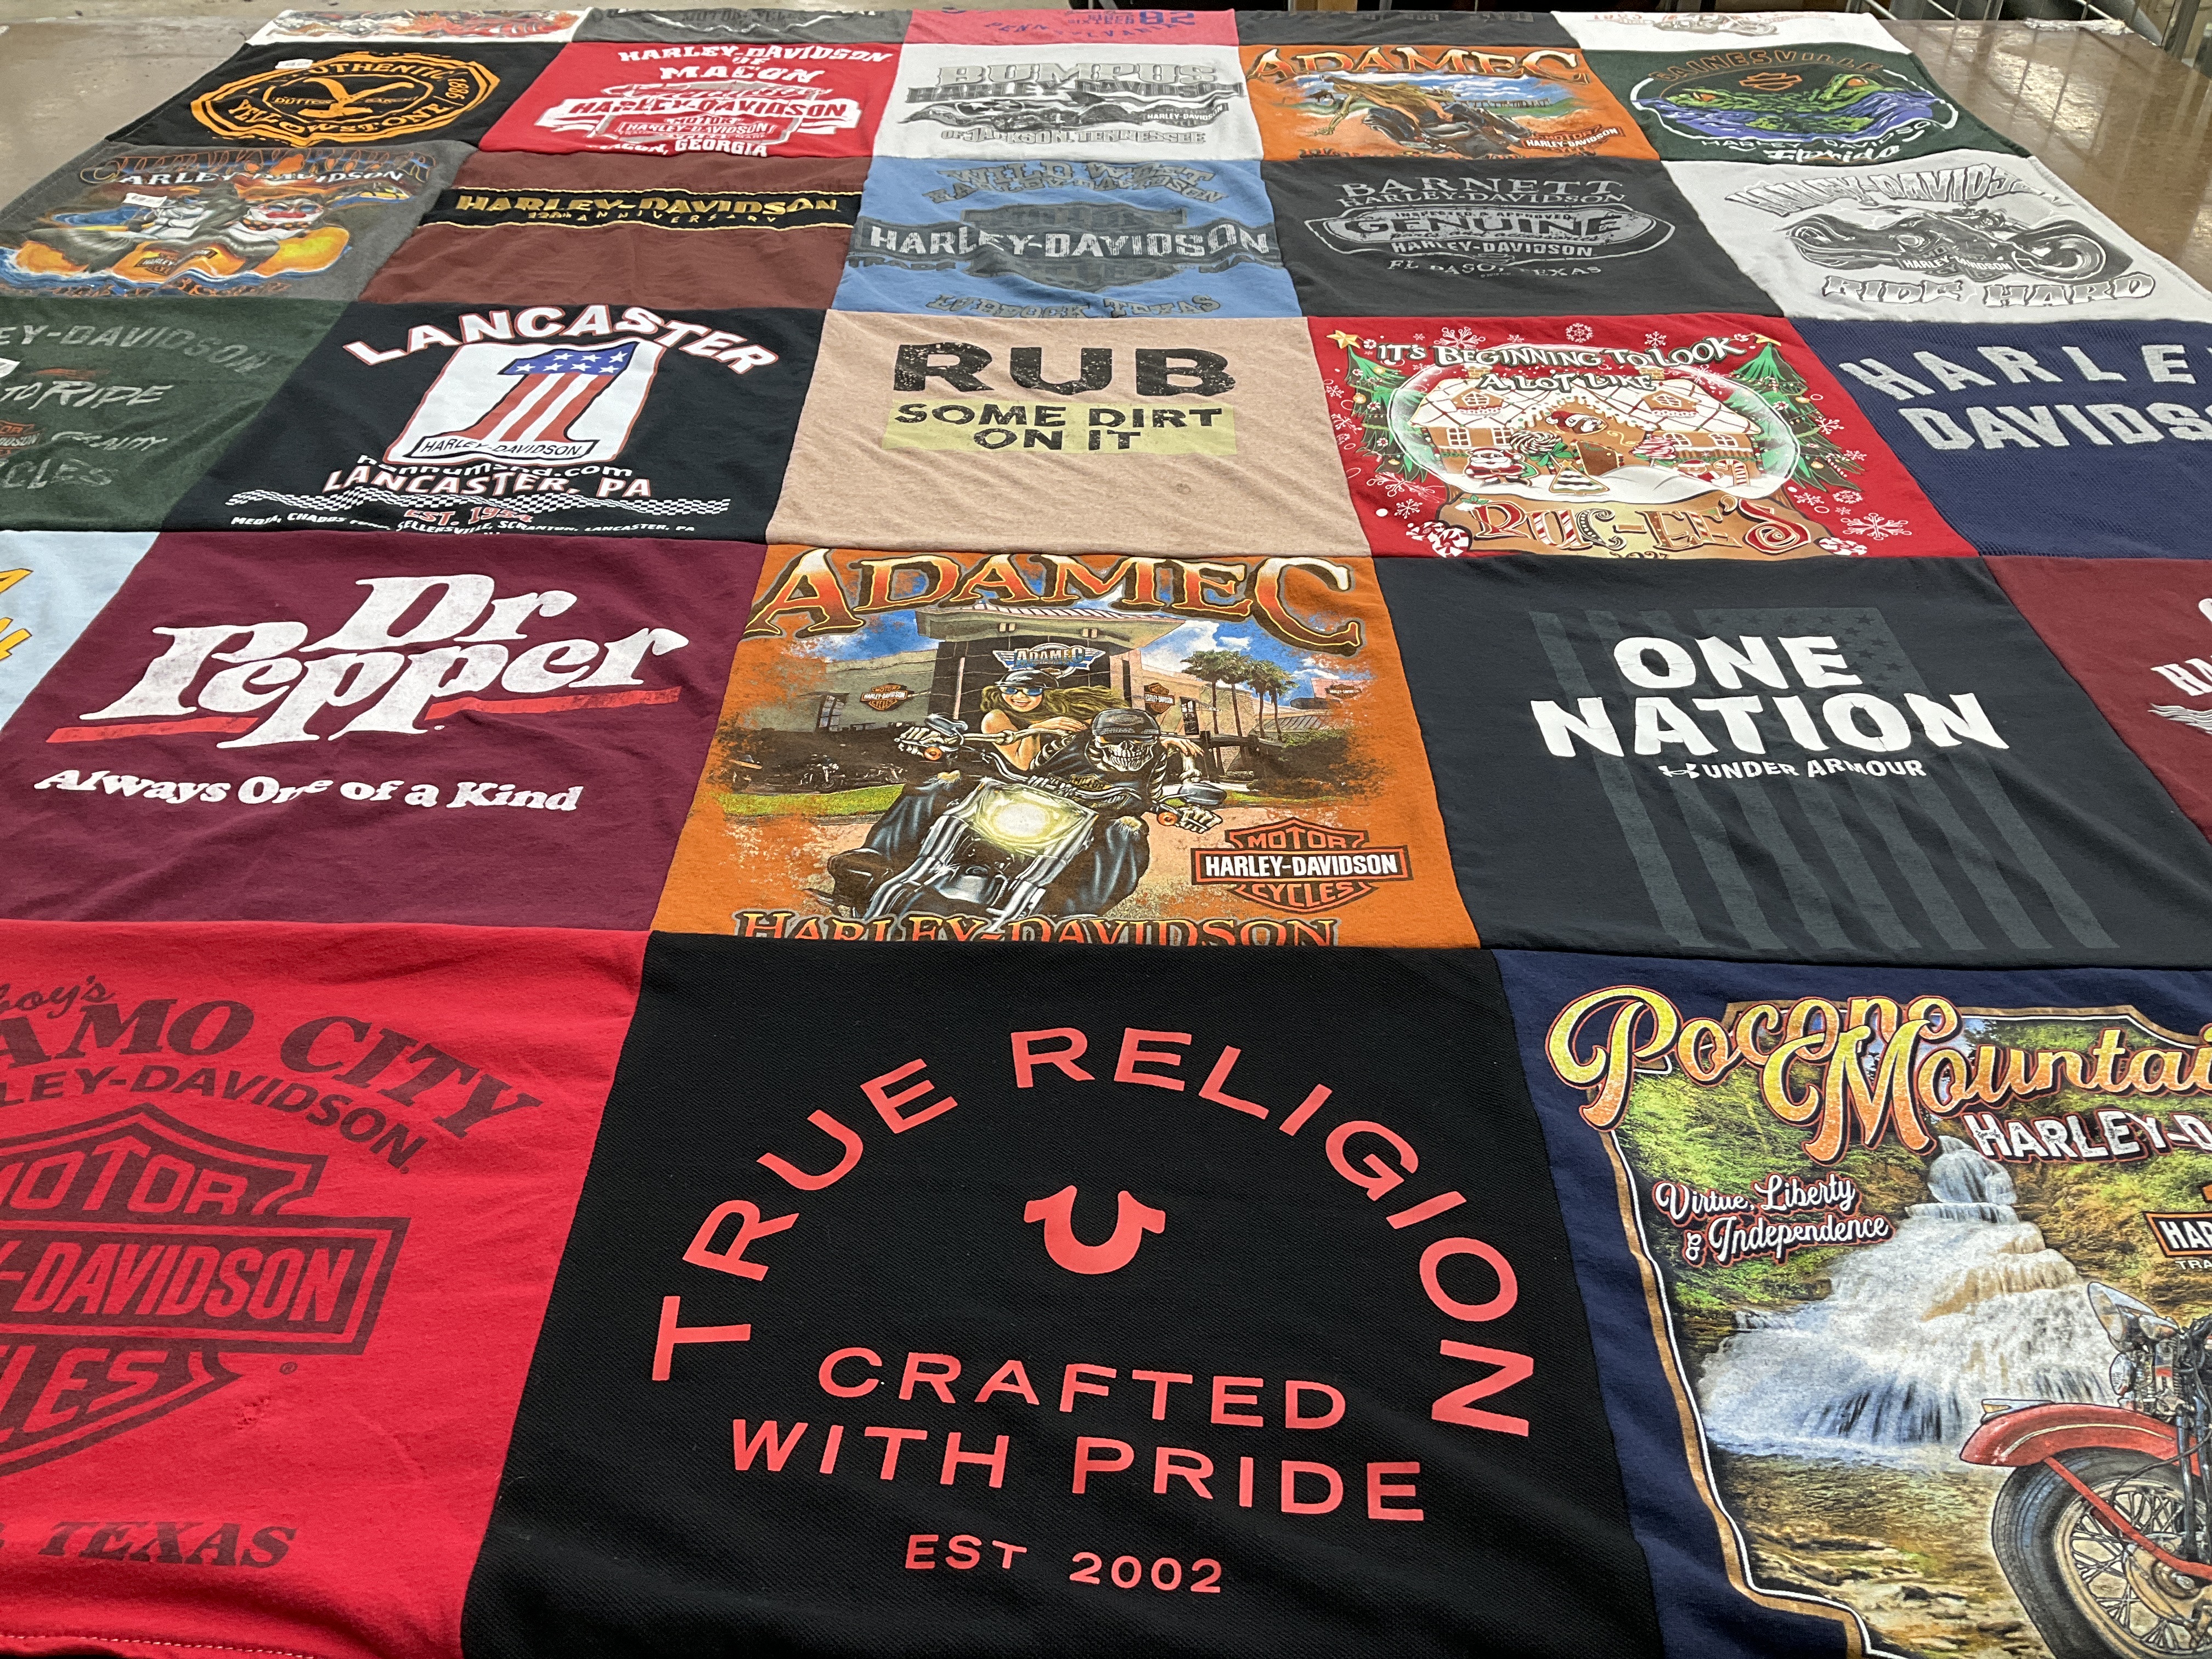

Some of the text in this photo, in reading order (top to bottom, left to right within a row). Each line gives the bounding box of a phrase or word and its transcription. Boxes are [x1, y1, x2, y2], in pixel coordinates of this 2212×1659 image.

[618, 45, 894, 63] HARLEY-DAVIDSON
[1247, 46, 1590, 84] ADAMEC
[1650, 50, 1884, 82] GAINESVILLE
[659, 66, 826, 83] MACON
[938, 63, 1218, 87] BUMPUS
[229, 99, 451, 134] YELLOWSTONE
[567, 98, 849, 118] HARLEY-DAVIDSON
[1147, 104, 1223, 121] HARLEY-DAVIDSON
[675, 138, 768, 157] GEORGIA
[1076, 129, 1206, 144] TENNESSEE
[1526, 128, 1618, 148] HARLEY-DAVIDSON
[1763, 144, 1900, 163] Florida
[938, 162, 1075, 184] WILD
[1334, 177, 1623, 198] BARNETT
[455, 194, 840, 215] HARLEY-DAVIDSON
[1336, 193, 1628, 207] HARLEY-DAVIDSON
[577, 209, 778, 224] ANNIVERSARY
[1345, 216, 1623, 238] GENUINE
[871, 222, 1269, 258] HARLEY-DAVIDSON
[1391, 240, 1593, 257] HARLEY-DAVIDSON
[1822, 275, 1965, 303] RIDE
[1983, 272, 2156, 307] HARD
[342, 304, 779, 375] LANCASTER
[1376, 336, 1747, 368] IT'S BEGINNING TO LOOK
[893, 342, 1237, 397] RUB
[1478, 371, 1658, 392] A LOT LIKE
[1838, 343, 2212, 401] HARLE
[28, 380, 174, 410] RIDE
[894, 403, 1223, 428] SOME DIRT
[1898, 402, 2212, 450] DAVIDS
[424, 438, 584, 458] HARLEY-DAVIDSON
[973, 427, 1142, 450] ON IT
[321, 465, 652, 498] LANCASTER, PA
[230, 514, 282, 526] MEDIA,
[396, 518, 493, 535] SELLERSVILLE,
[499, 520, 579, 532] SCRANTON,
[584, 523, 670, 532] LANCASTER,
[404, 509, 460, 526] EST.
[1471, 494, 1822, 554] BUC-EE'S
[300, 574, 579, 650] Dr
[742, 545, 1366, 656] ADAMEC
[1014, 646, 1086, 667] ADAMEC
[1613, 635, 1864, 690] ONE
[78, 620, 690, 750] Pepper
[1530, 692, 2011, 758] NATION
[1702, 758, 1928, 779] UNDER ARMOUR
[33, 769, 585, 812] Always One of a Kind
[1248, 826, 1346, 849] MOTOR
[1205, 853, 1398, 877] HARLEY-DAVIDSON
[1252, 881, 1352, 907] CYCLES
[740, 910, 1339, 947] HARLEY-DAVIDSON
[1545, 984, 1962, 1132] Pocono
[279, 1015, 545, 1140] CITY
[0, 1141, 250, 1216] OTOR
[1655, 1173, 1856, 1220] Virtue, Liberty
[652, 1026, 1535, 1438] TRUE RELIGION
[1685, 1215, 1889, 1262] & Independence
[818, 1346, 1347, 1429] CRAFTED
[732, 1418, 1425, 1521] WITH PRIDE
[38, 1520, 298, 1569] TEXAS
[905, 1534, 1222, 1594] EST 2002
